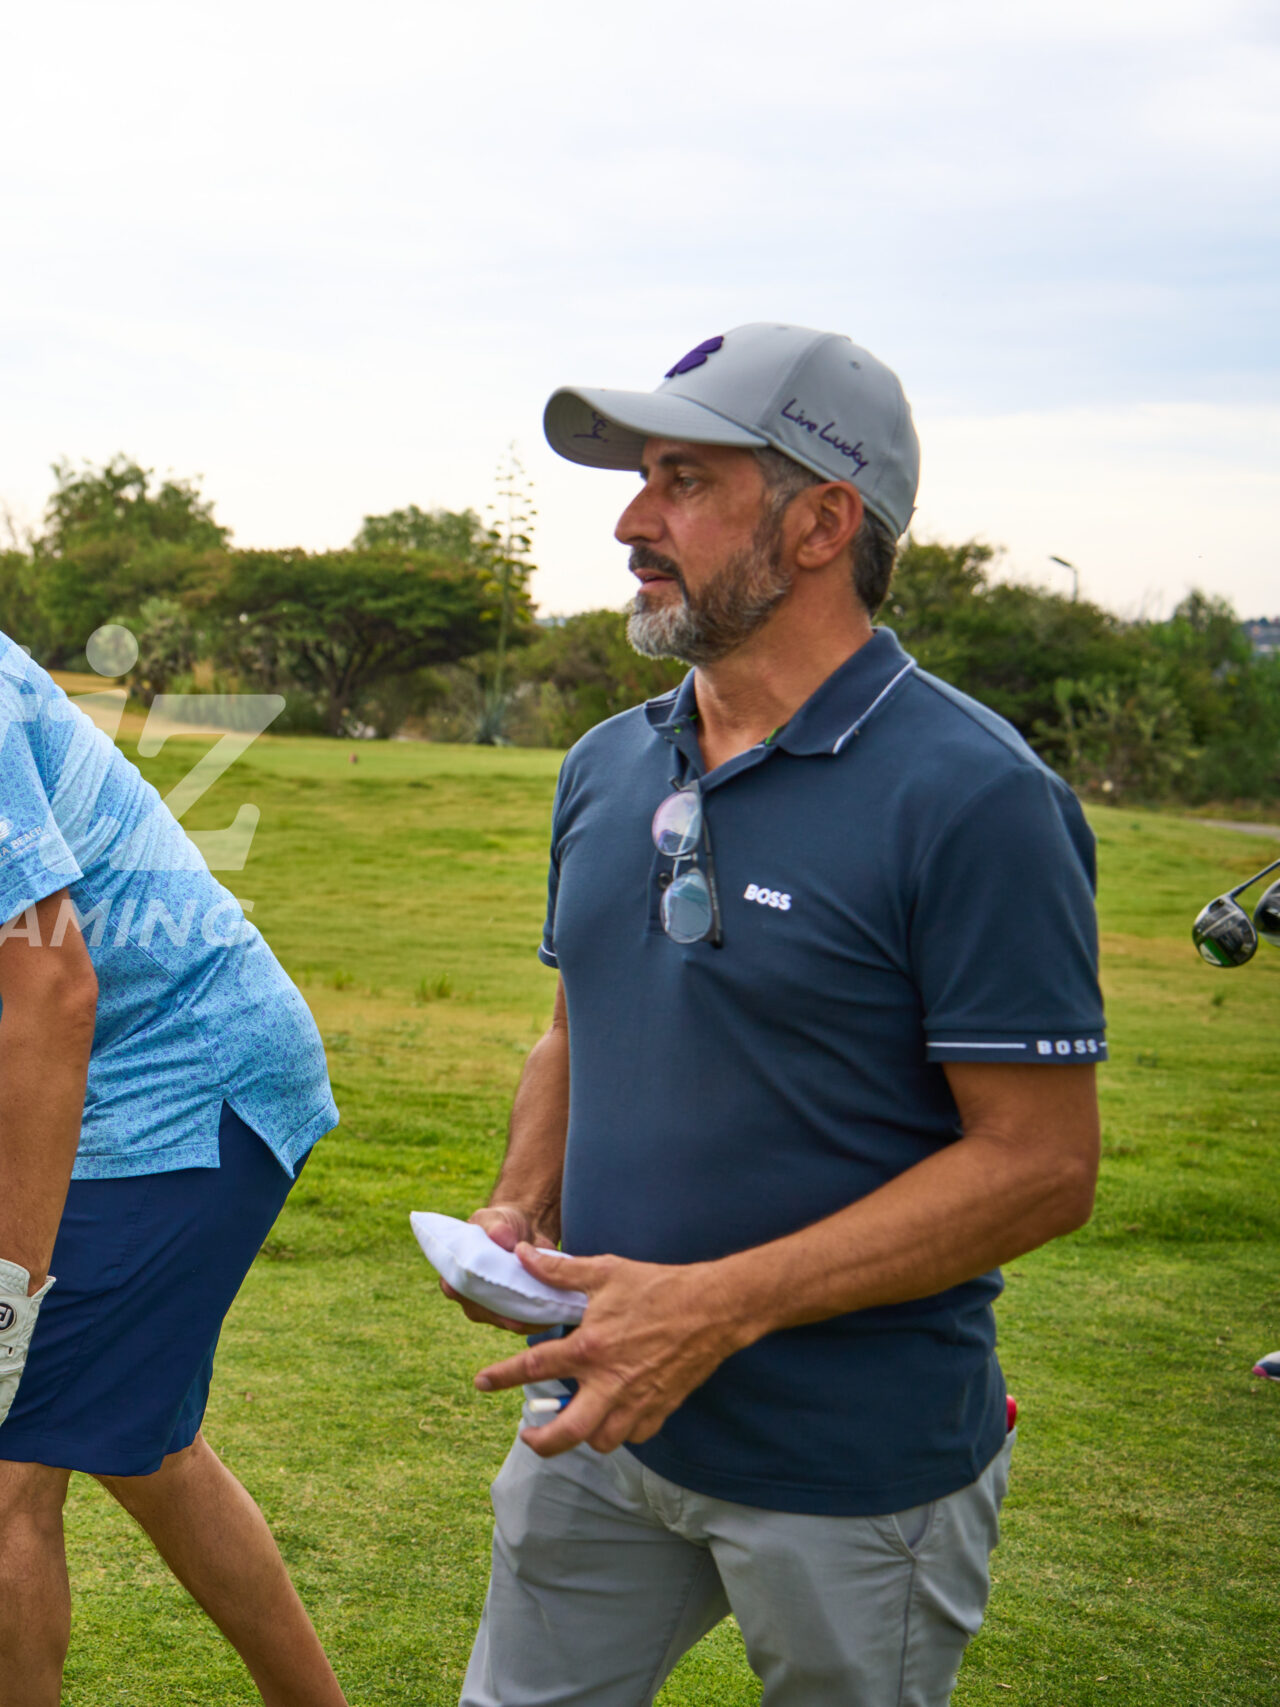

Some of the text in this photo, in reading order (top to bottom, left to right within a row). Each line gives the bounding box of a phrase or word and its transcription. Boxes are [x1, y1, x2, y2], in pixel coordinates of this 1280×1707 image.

[781, 398, 869, 477] Live Lucky
[11, 826, 42, 849] BEACH
[743, 883, 792, 911] BOSS
[1036, 1039, 1098, 1055] BOSS
